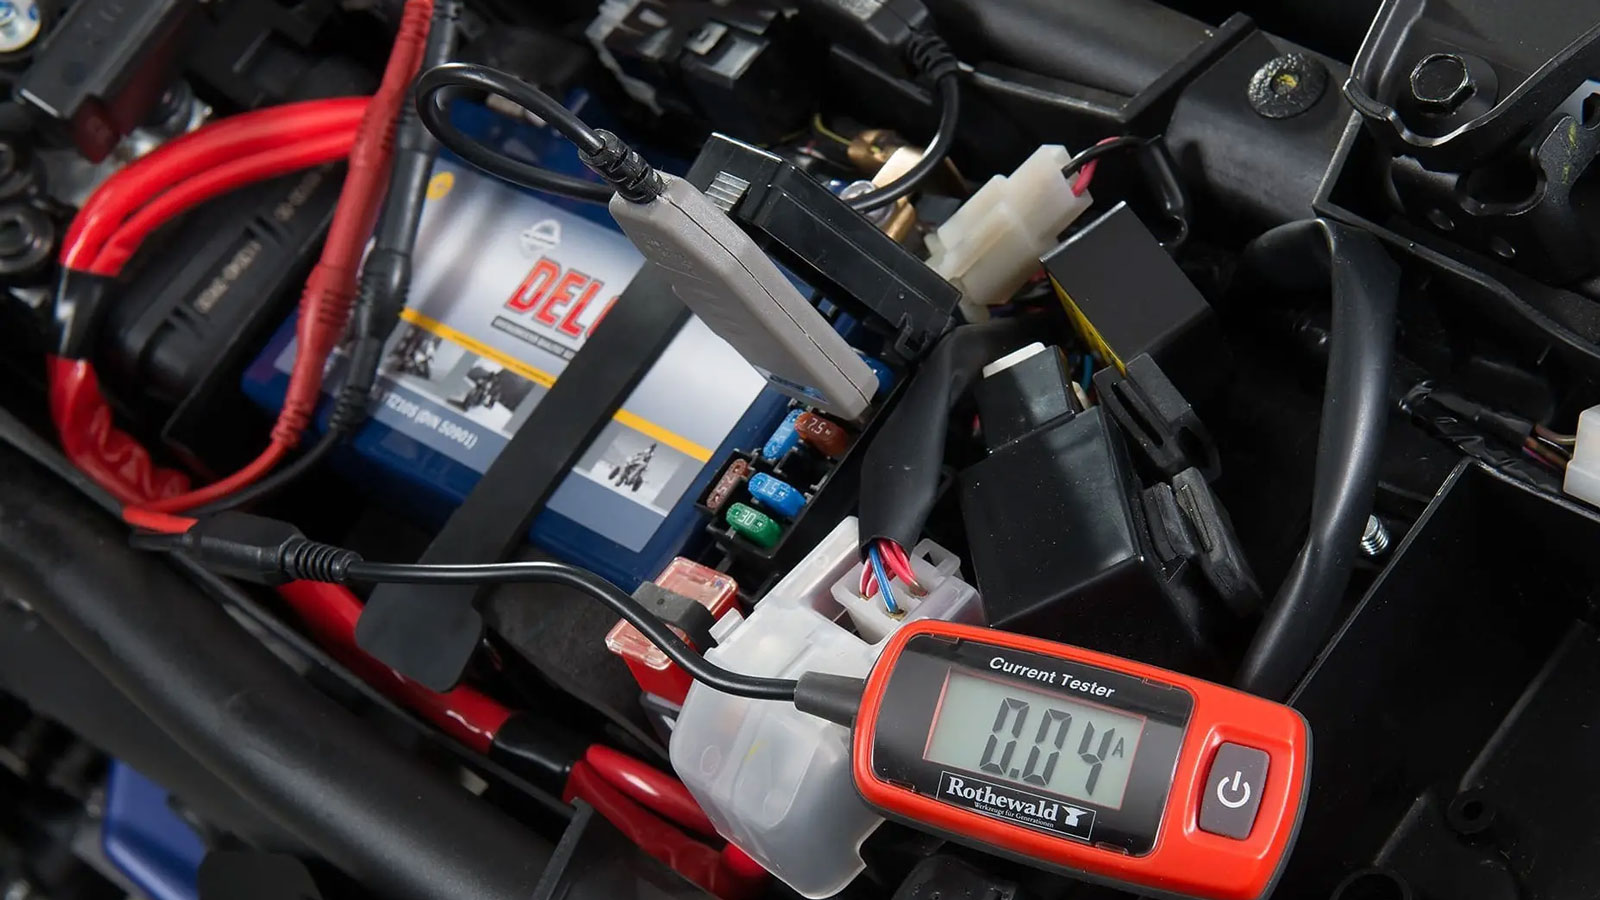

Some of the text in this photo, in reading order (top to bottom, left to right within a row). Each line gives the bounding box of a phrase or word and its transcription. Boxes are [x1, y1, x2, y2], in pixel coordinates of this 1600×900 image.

[503, 255, 620, 340] DEL
[807, 417, 826, 434] 7.5
[738, 509, 757, 526] 30
[989, 656, 1116, 699] Current Tester
[979, 697, 1116, 797] 0.04
[946, 776, 1058, 822] Rothewald
[974, 802, 1055, 829] Werkzeuge für Generationen
